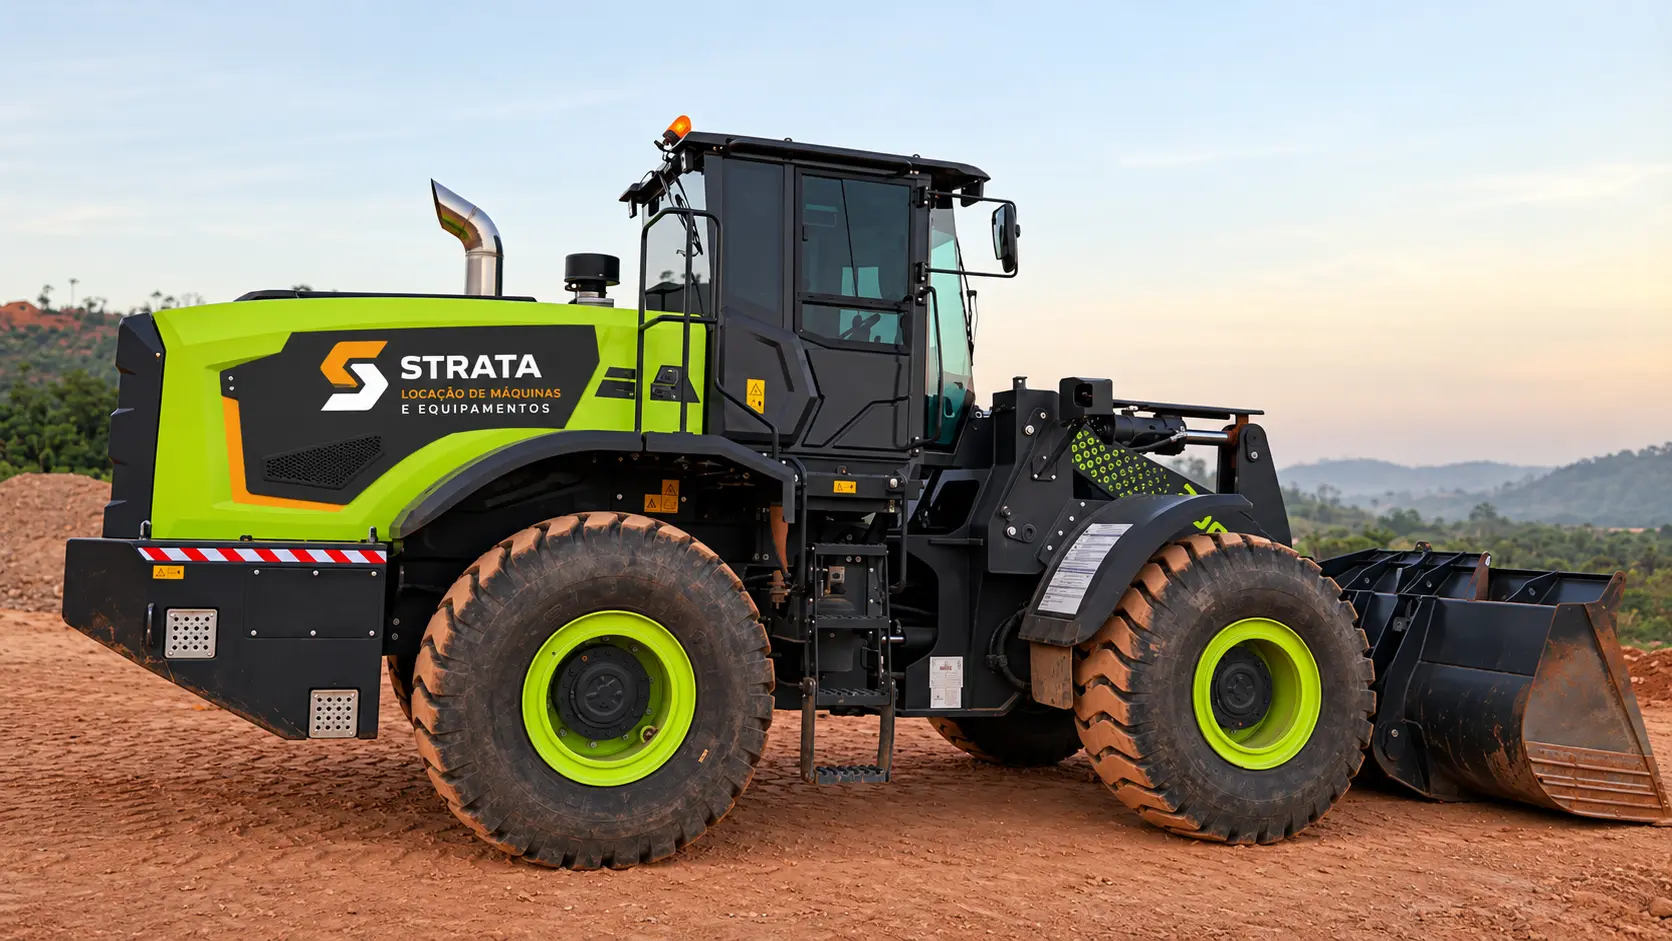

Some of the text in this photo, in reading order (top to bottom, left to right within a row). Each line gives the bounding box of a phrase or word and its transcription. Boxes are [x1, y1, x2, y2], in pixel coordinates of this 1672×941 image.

[401, 354, 542, 379] STRATA
[401, 386, 562, 402] LOCAÇÃO DE MÁQUINAS
[401, 403, 550, 416] E EQUIPAMENTOS
